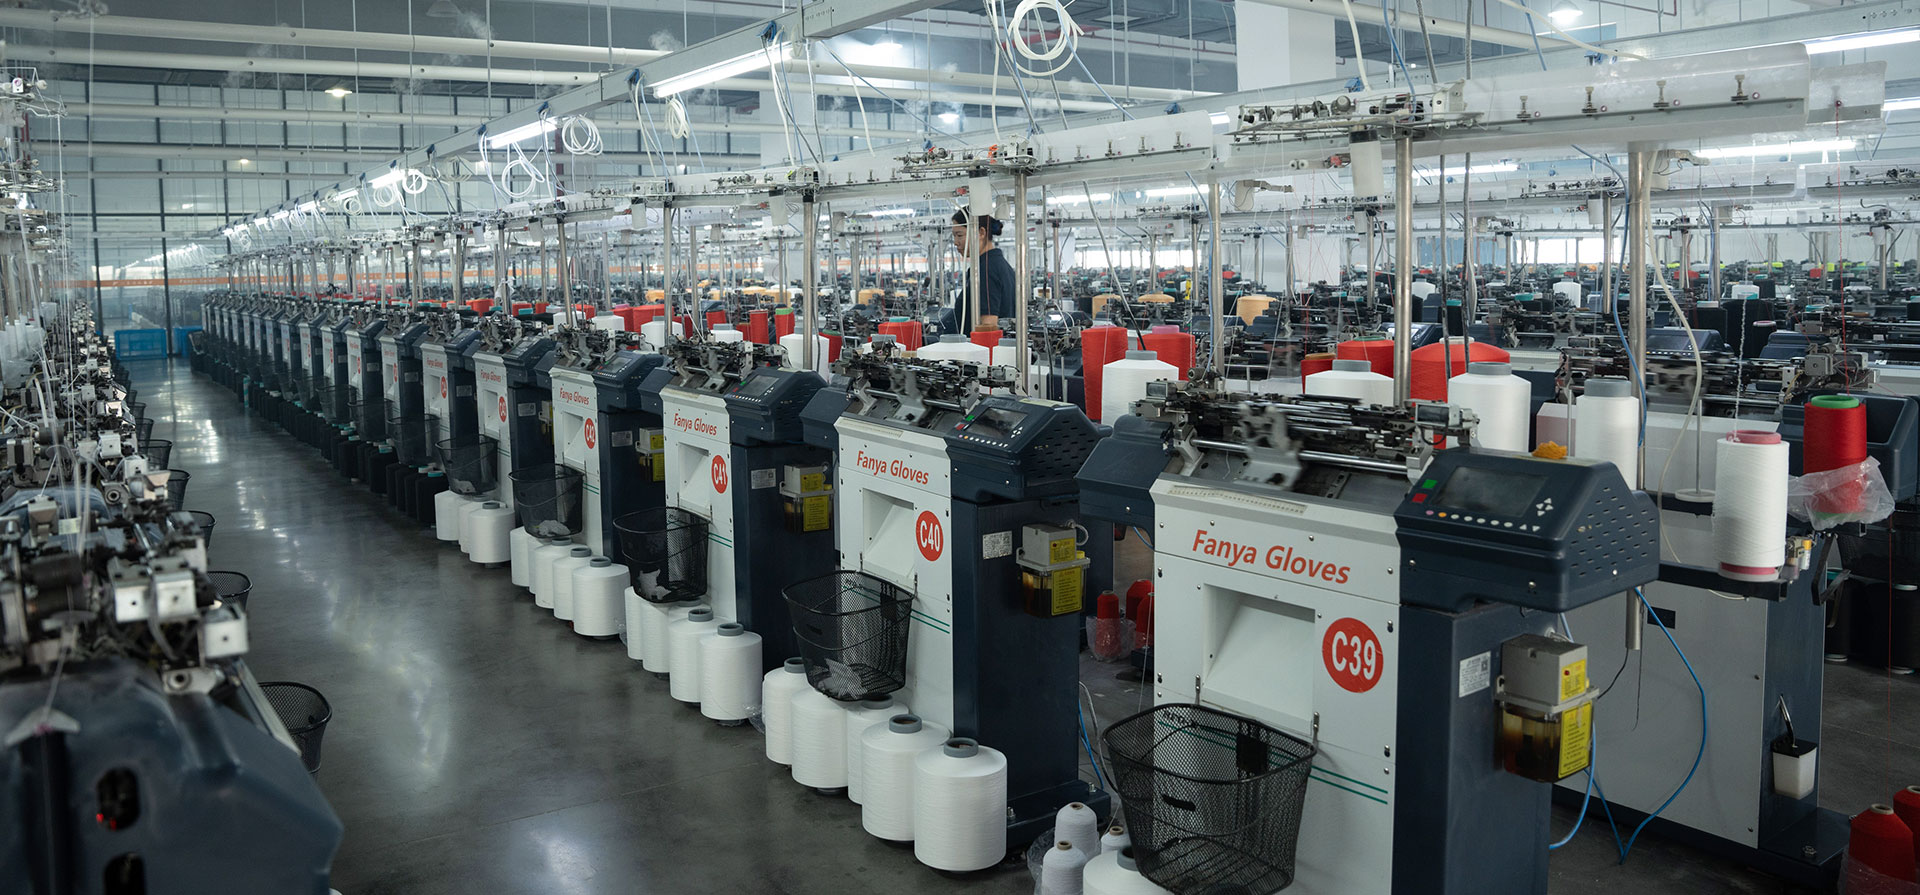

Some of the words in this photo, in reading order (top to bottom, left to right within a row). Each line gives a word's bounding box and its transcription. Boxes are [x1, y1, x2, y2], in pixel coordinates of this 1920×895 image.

[559, 387, 572, 403] Fanya
[573, 391, 590, 406] Gloves
[673, 412, 692, 432] Fanya
[694, 417, 717, 436] Gloves
[713, 463, 727, 486] C41
[857, 450, 888, 476] Fanya
[889, 459, 929, 485] Gloves
[919, 519, 941, 553] C40
[1192, 529, 1257, 567] Fanya
[1265, 545, 1351, 584] Gloves
[1331, 630, 1377, 681] C39
